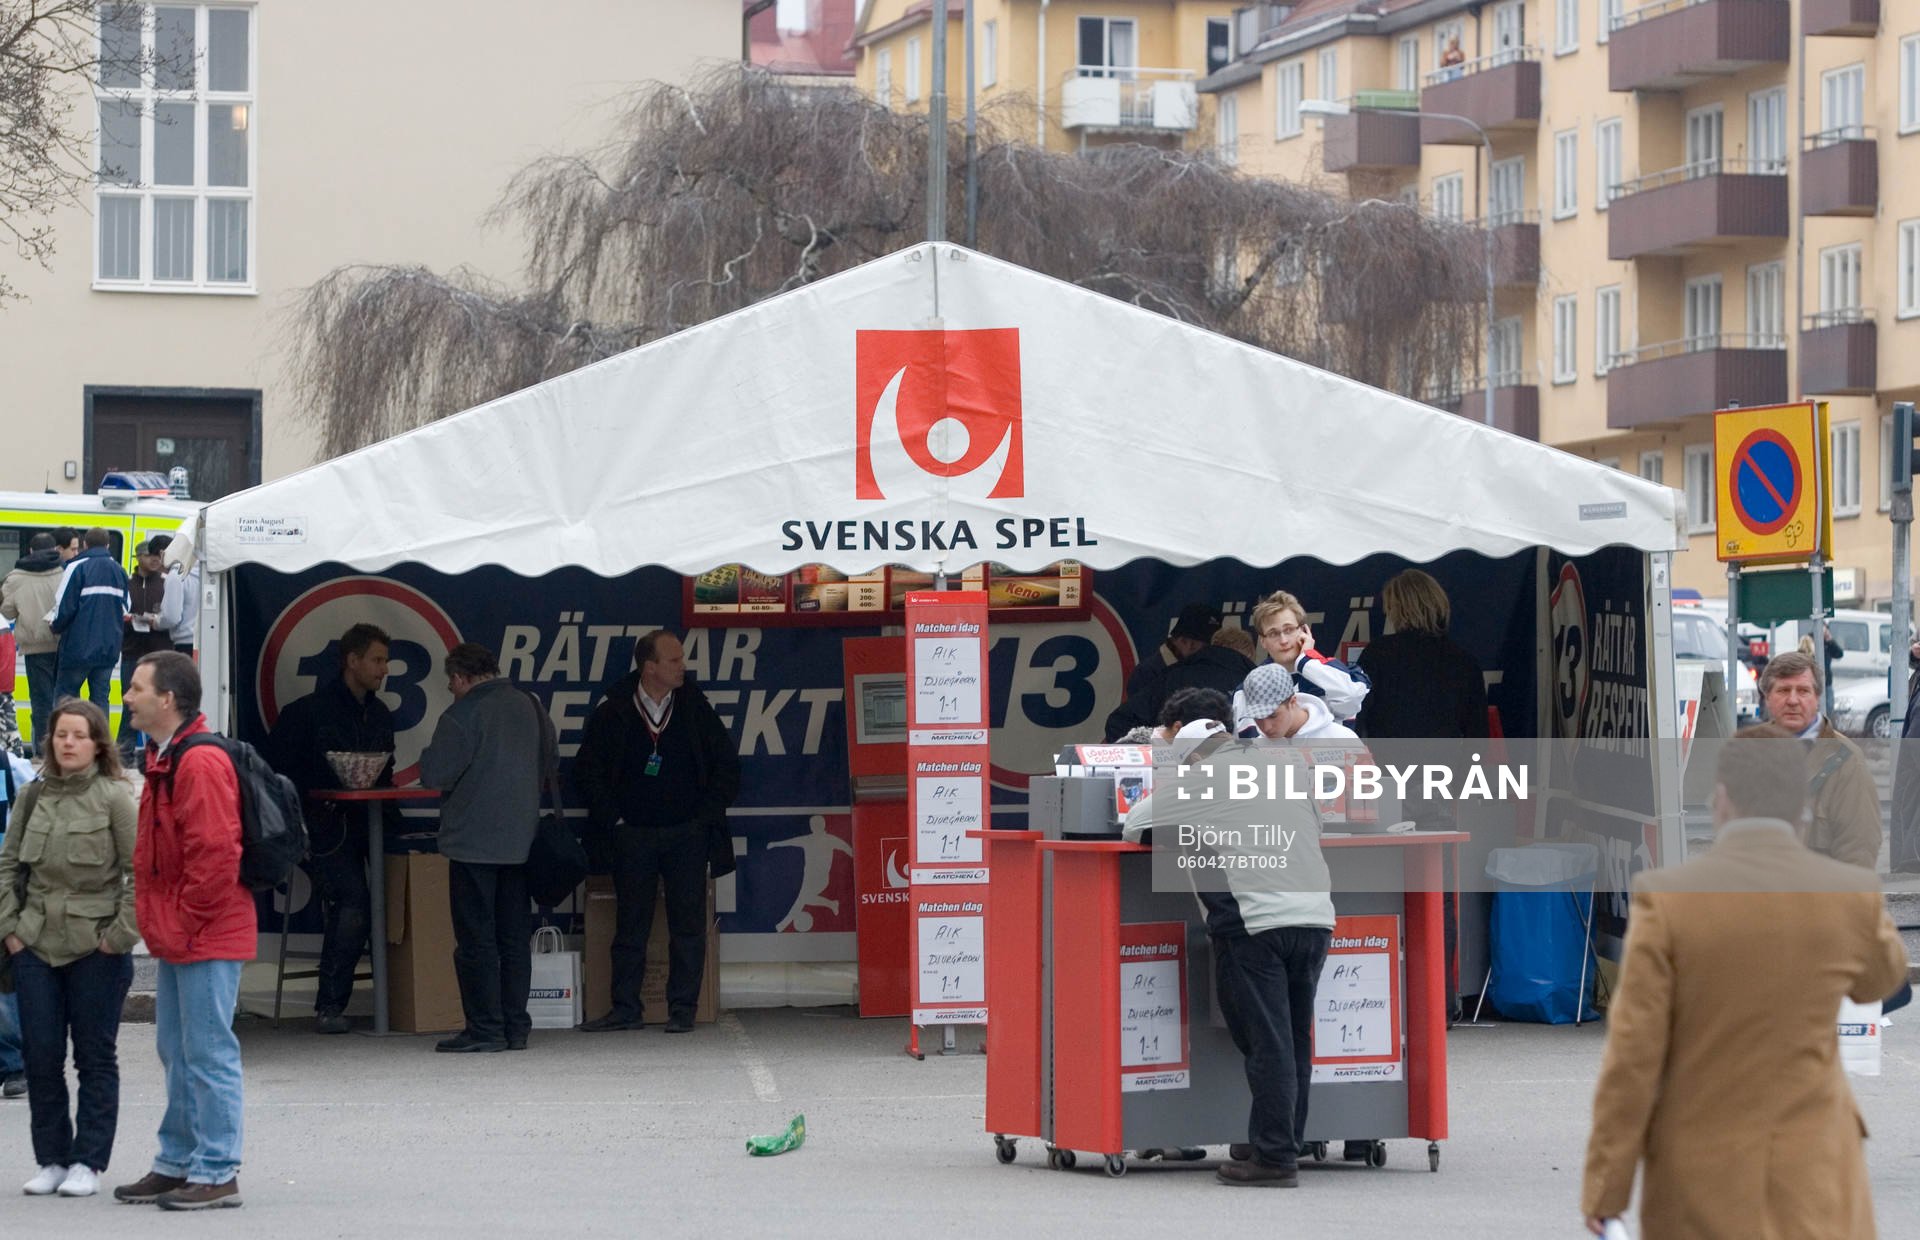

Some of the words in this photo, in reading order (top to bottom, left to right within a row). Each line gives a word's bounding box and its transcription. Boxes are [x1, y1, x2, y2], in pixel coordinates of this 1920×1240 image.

[781, 519, 979, 551] SVENSKA
[995, 516, 1099, 549] SPEL
[1006, 582, 1041, 599] Keno
[915, 623, 957, 634] Matchen
[1591, 599, 1624, 672] RÄTT
[932, 646, 958, 661] AIK
[939, 695, 958, 713] 1-1
[1583, 680, 1649, 759] RESPEKT
[916, 762, 959, 772] Matchen
[932, 785, 959, 799] AIK
[941, 834, 960, 853] 1-1
[918, 903, 960, 912] Matchen
[934, 924, 962, 941] AIK
[1132, 973, 1157, 989] AIK
[1332, 964, 1364, 981] AIK
[942, 975, 960, 993] 1-1
[1340, 1024, 1363, 1043] 1-1
[1139, 1035, 1159, 1055] 1-1
[1135, 1077, 1174, 1086] MATCHEN
[1333, 1069, 1382, 1077] MATCHEN
